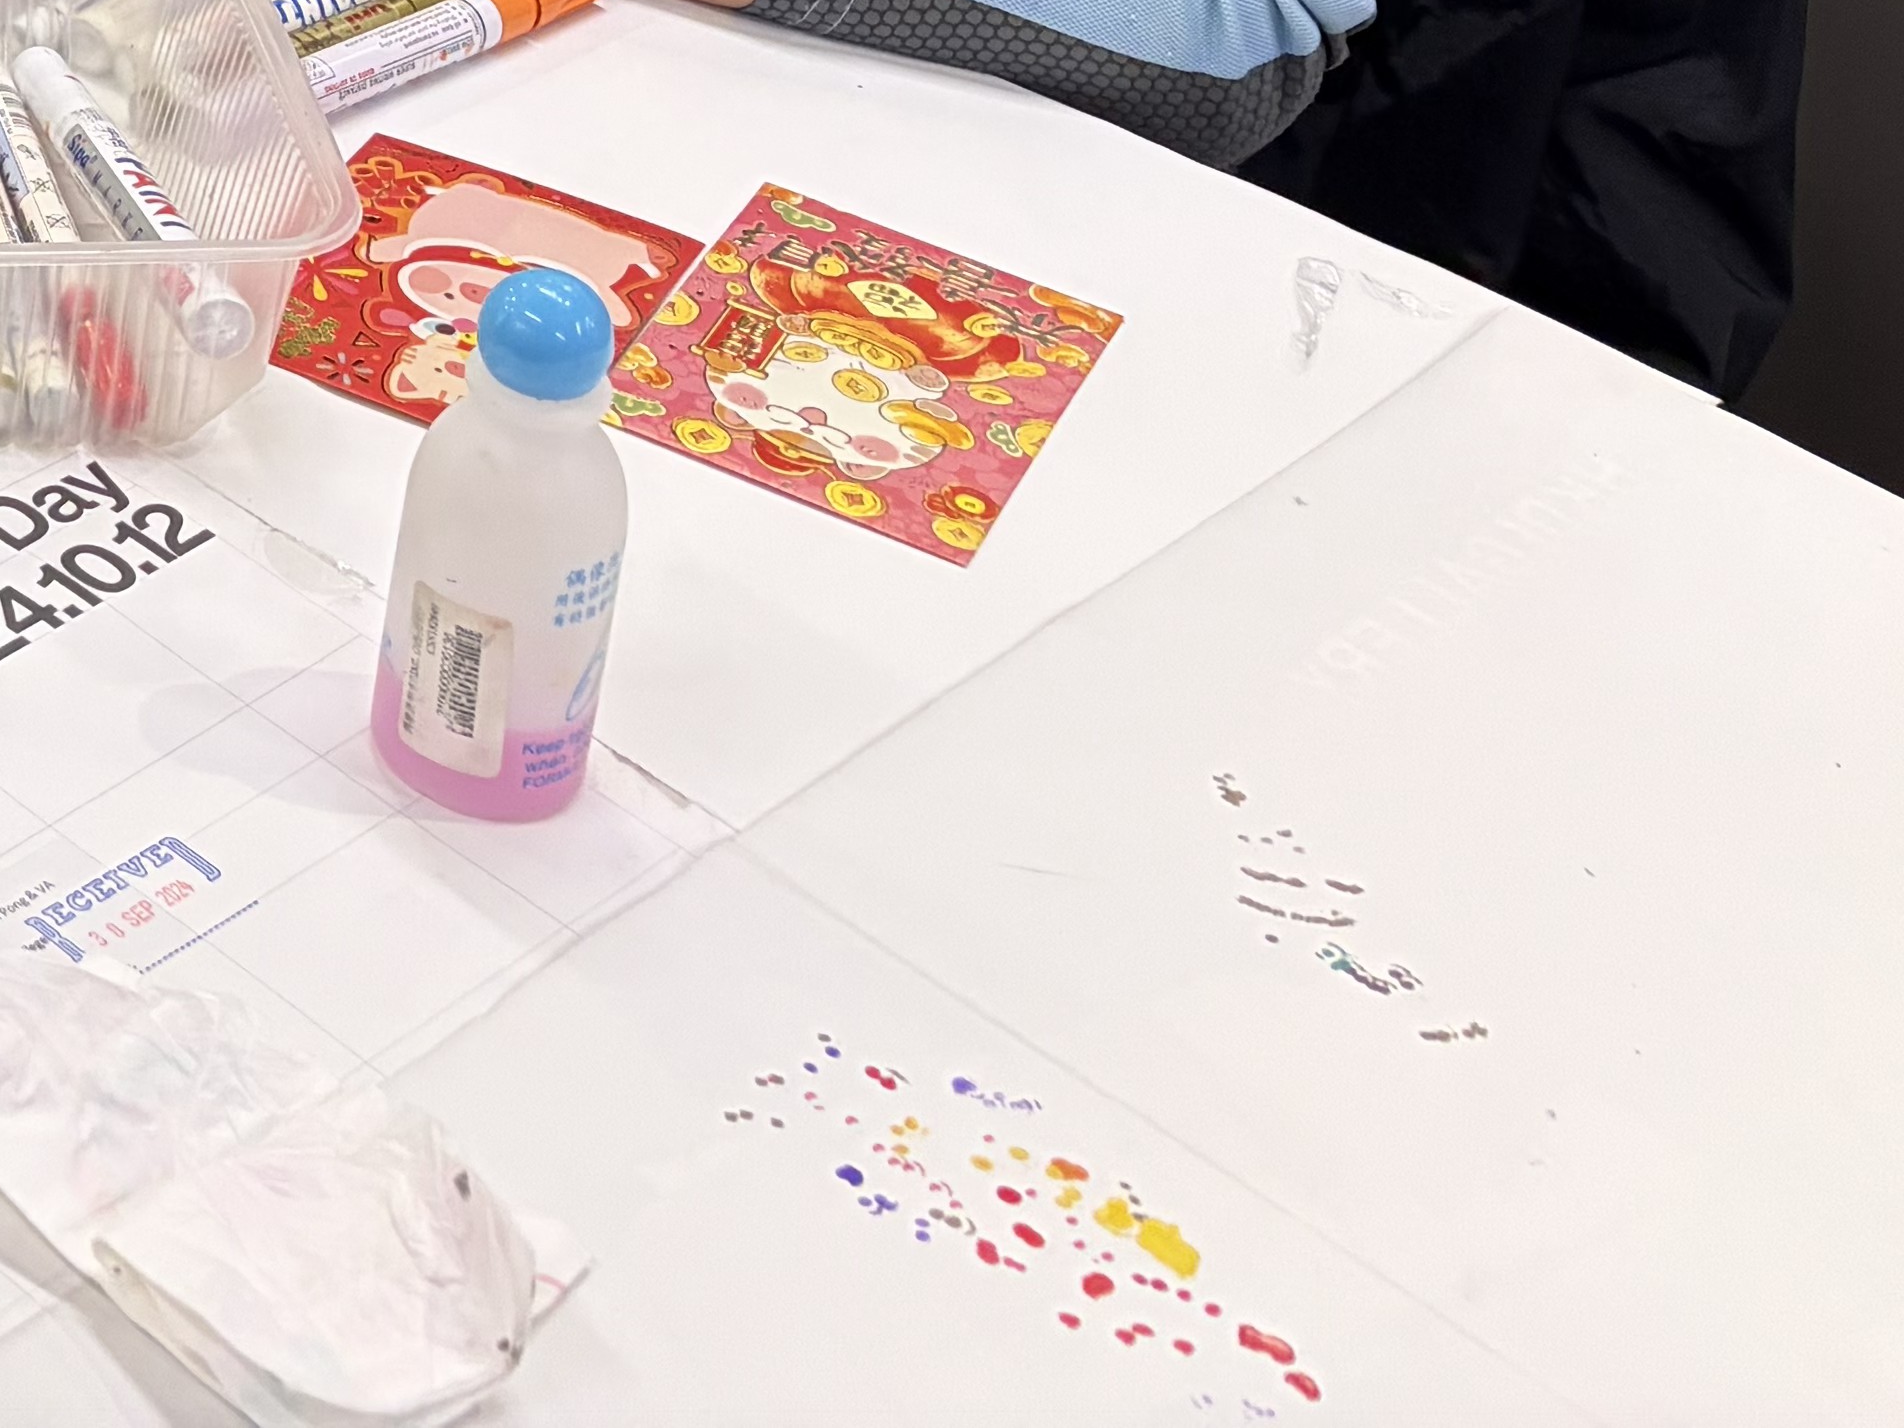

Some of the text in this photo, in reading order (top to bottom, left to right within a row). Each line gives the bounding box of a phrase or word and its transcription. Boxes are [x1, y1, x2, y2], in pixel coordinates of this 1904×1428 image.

[342, 1, 393, 32] uni
[24, 836, 222, 964] RECEIVED
[33, 876, 56, 896] VA
[120, 899, 154, 927] SEP
[155, 879, 196, 908] 2024
